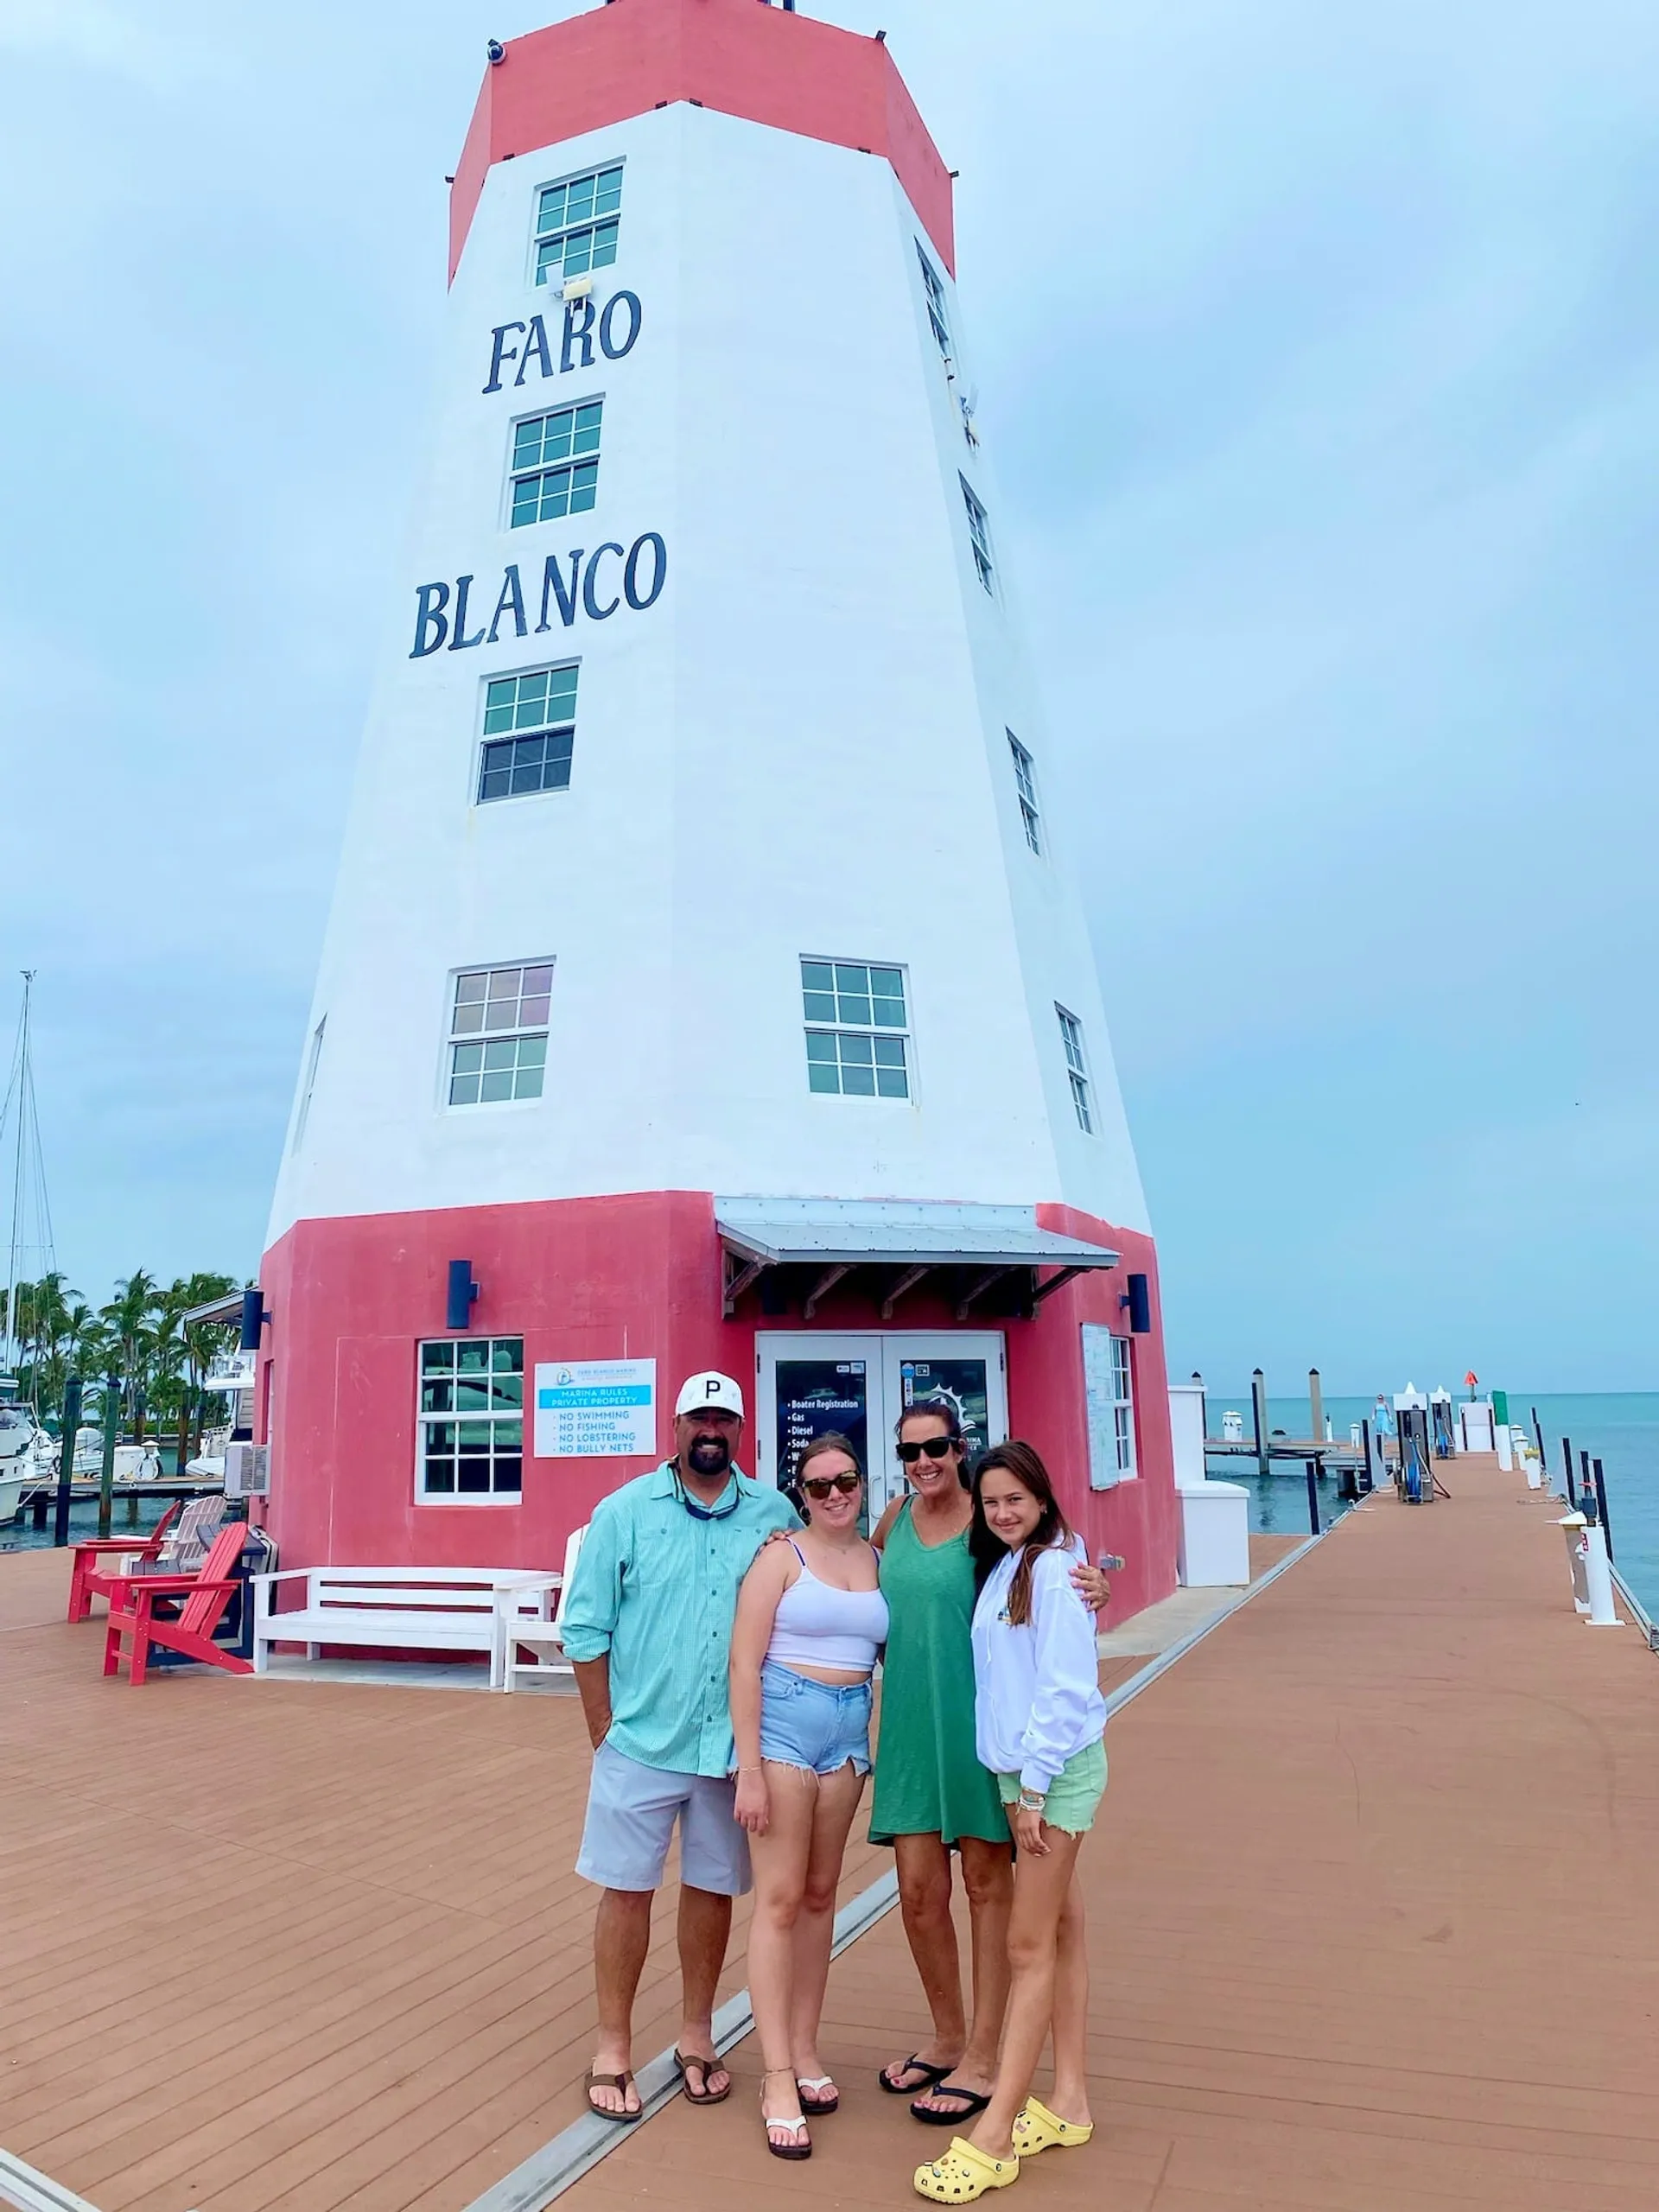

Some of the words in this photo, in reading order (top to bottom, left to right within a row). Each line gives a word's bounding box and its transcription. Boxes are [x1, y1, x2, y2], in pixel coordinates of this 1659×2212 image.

[481, 290, 642, 394] FARO
[408, 531, 667, 659] BLANCO
[601, 1388, 627, 1396] RULES
[705, 1380, 721, 1400] P
[551, 1398, 588, 1407] PRIVATE
[591, 1396, 638, 1406] PROPERTY
[791, 1399, 815, 1408] Boater
[817, 1399, 859, 1410] Registration
[559, 1412, 574, 1421] NO
[577, 1410, 630, 1421] SWIMMING
[791, 1413, 804, 1421] Gas
[559, 1423, 574, 1432] NO
[577, 1422, 616, 1432] FISHING
[791, 1426, 813, 1435] Diesel
[559, 1433, 574, 1442] NO
[577, 1432, 636, 1442] LOBSTERING
[559, 1445, 574, 1453] NO
[577, 1444, 606, 1452] BULLY
[609, 1443, 633, 1452] NETS
